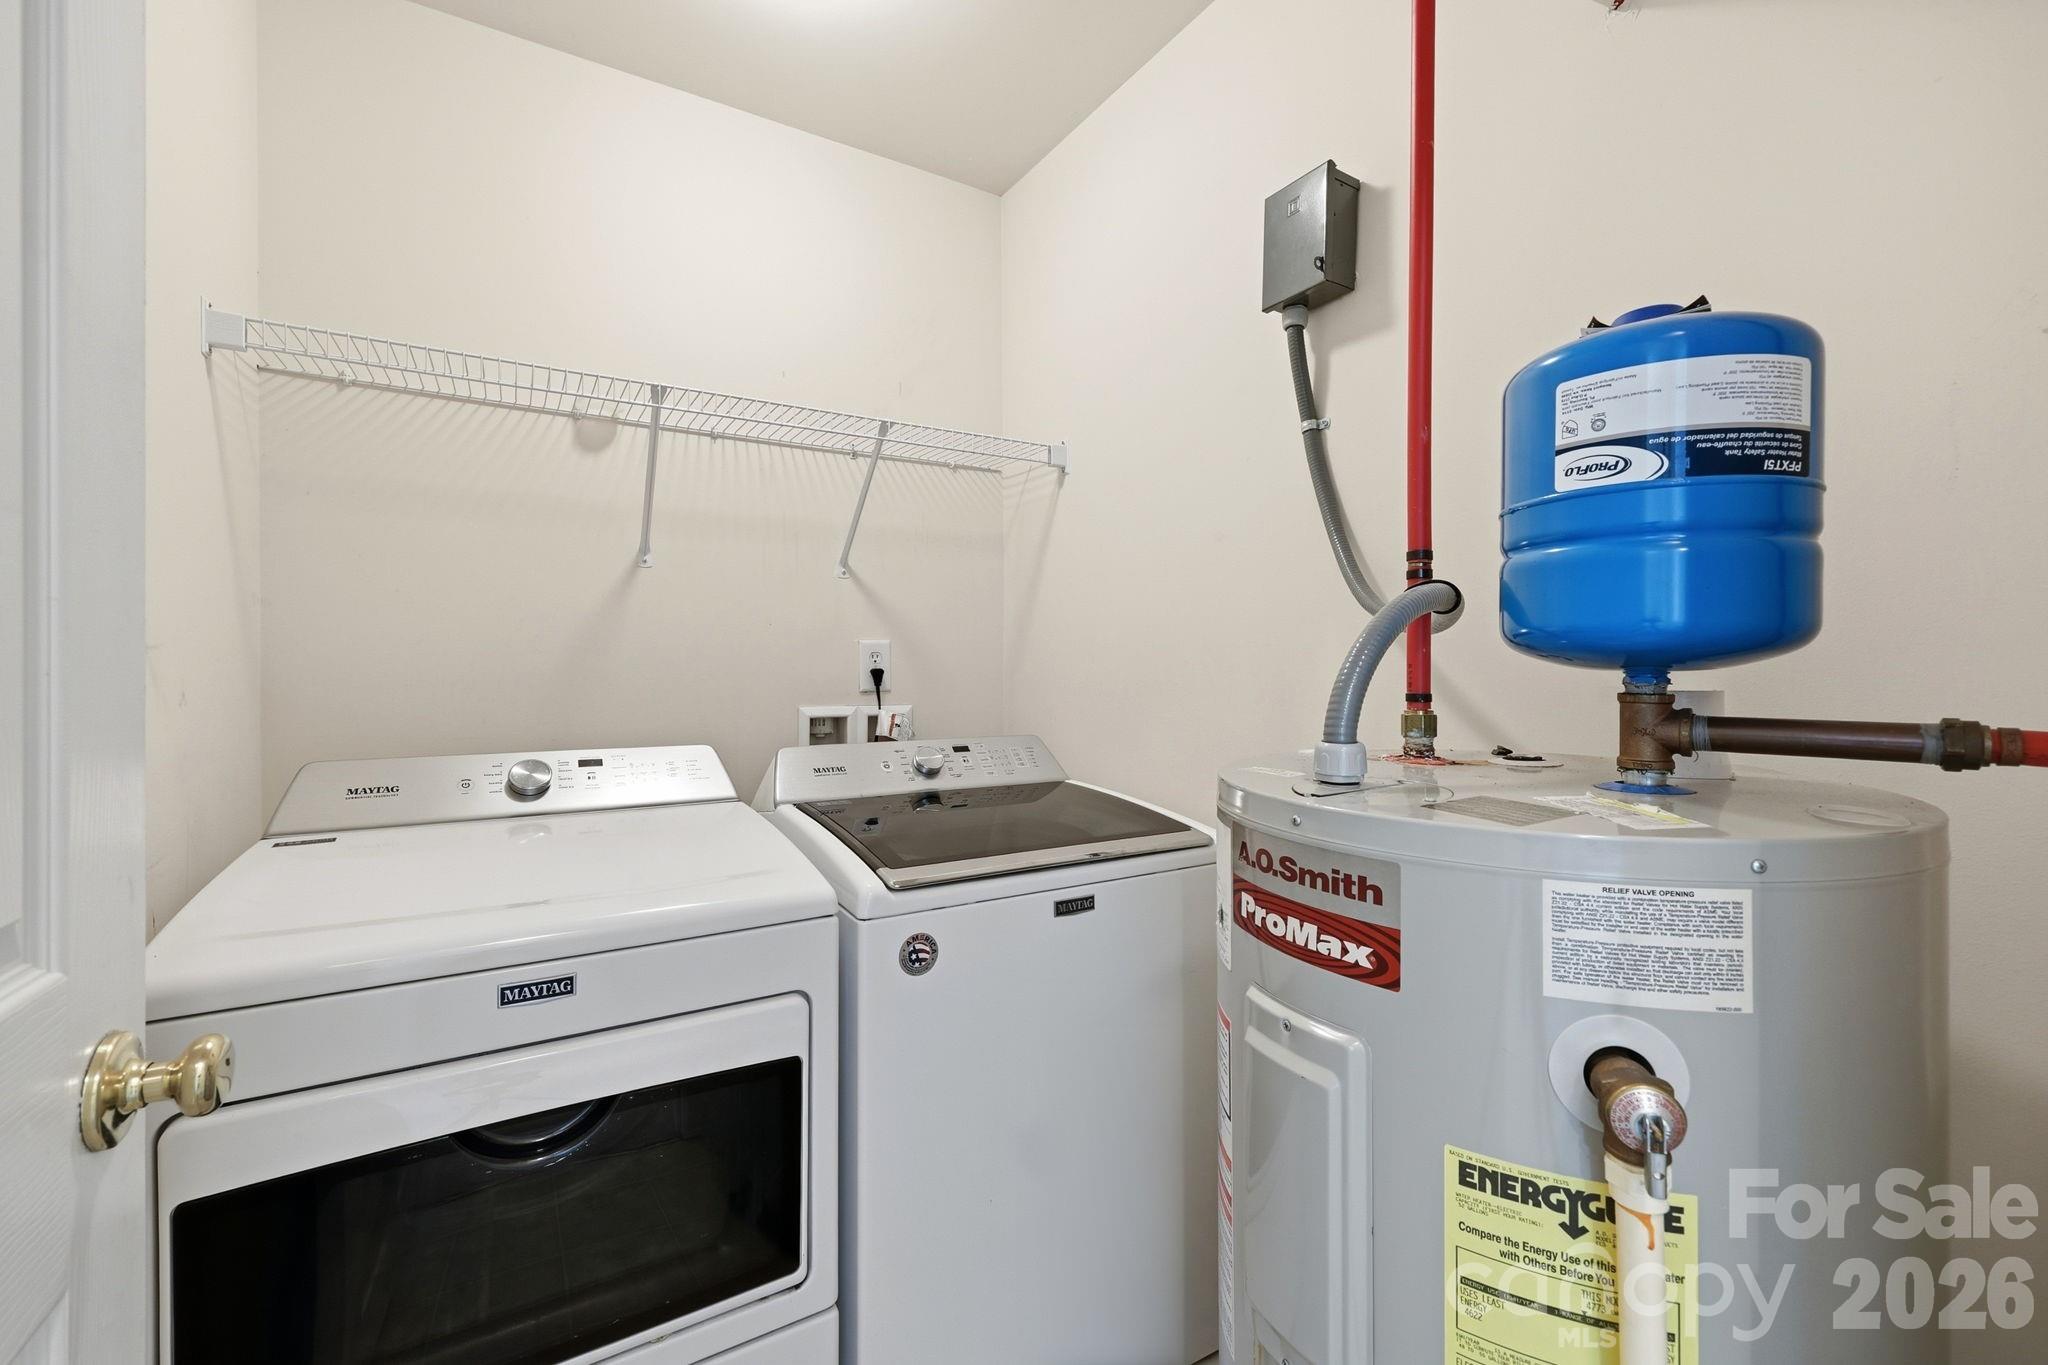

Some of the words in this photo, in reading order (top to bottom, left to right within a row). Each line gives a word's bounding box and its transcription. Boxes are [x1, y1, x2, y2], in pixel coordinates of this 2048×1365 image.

[1682, 433, 1725, 441] calentador
[1740, 431, 1774, 439] seguridad
[1744, 448, 1766, 456] Safety
[1565, 459, 1620, 477] PROFLO
[813, 766, 846, 774] MAYTAG
[346, 785, 400, 796] MAYTAG
[1238, 841, 1384, 907] A.O.Smith
[1602, 886, 1630, 894] RELIEF
[1632, 888, 1657, 896] VALVE
[1058, 899, 1093, 913] MAYTAG
[1241, 891, 1375, 970] ProMax
[906, 934, 937, 954] AMERICA
[503, 980, 571, 1002] MAYTAG
[1475, 1158, 1500, 1170] STANDARD
[1517, 1170, 1550, 1183] GOVERNMENT
[1459, 1159, 1684, 1235] ENERGYGE
[1458, 1221, 1501, 1244] Compare
[1504, 1236, 1520, 1249] the
[1522, 1242, 1558, 1262] Energy
[1560, 1251, 1581, 1265] Use
[1583, 1257, 1594, 1269] of
[1596, 1260, 1617, 1274] this
[1665, 1273, 1686, 1284] ater
[1499, 1249, 1520, 1263] with
[1522, 1255, 1557, 1274] Others
[1560, 1265, 1594, 1282] Before
[1594, 1272, 1616, 1287] You
[1460, 1286, 1479, 1301] USES
[1482, 1295, 1505, 1310] LEAST
[1460, 1296, 1488, 1313] ENERGY
[1581, 1289, 1601, 1303] THIS
[1465, 1307, 1483, 1322] 4622
[1586, 1301, 1606, 1313] 4773
